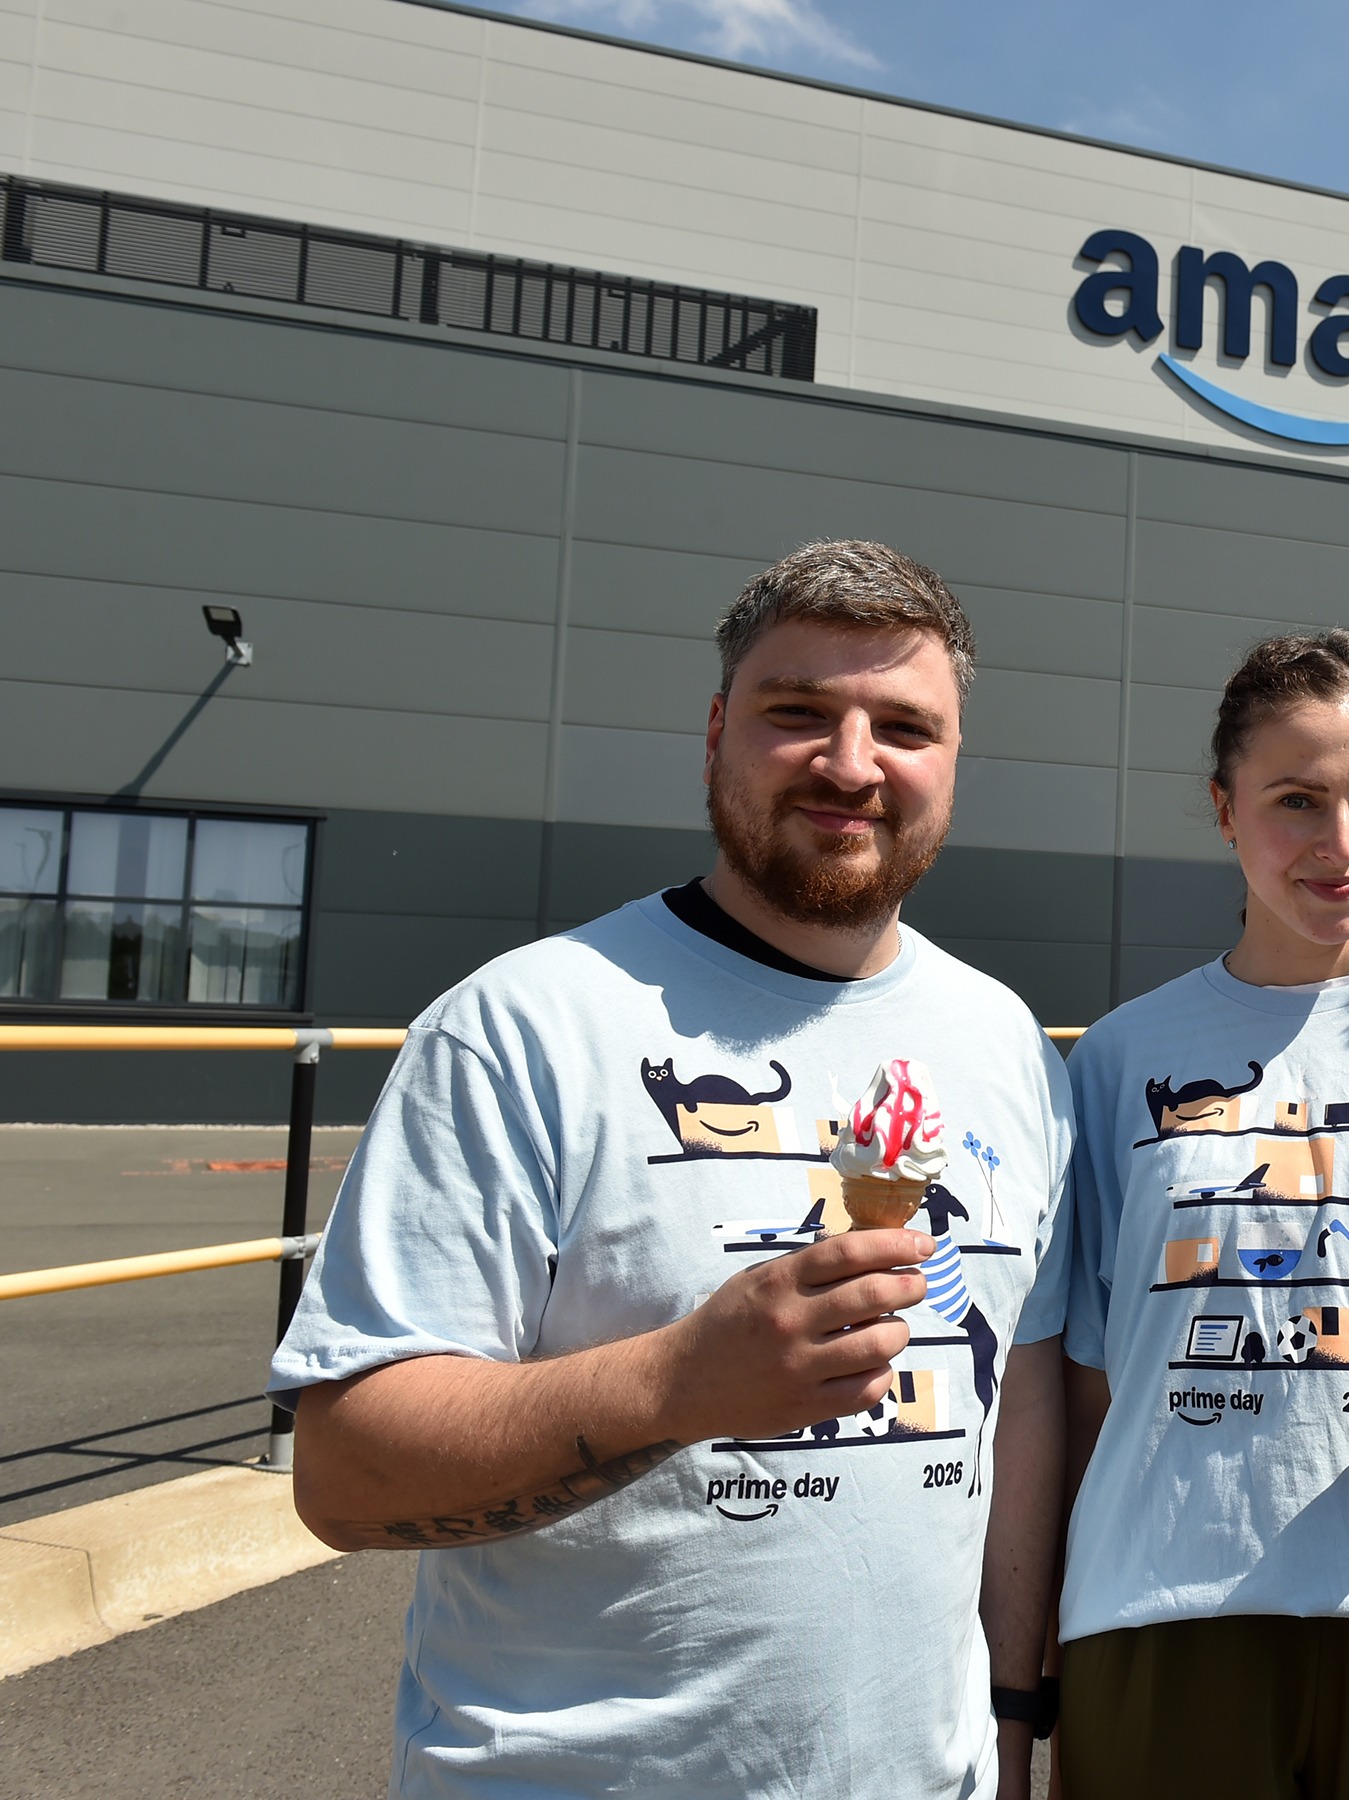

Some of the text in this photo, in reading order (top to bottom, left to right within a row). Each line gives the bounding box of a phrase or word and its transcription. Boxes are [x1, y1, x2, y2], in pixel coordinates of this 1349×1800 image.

[1169, 1386, 1264, 1415] prime day
[706, 1472, 840, 1505] prime day
[923, 1461, 964, 1489] 2026
